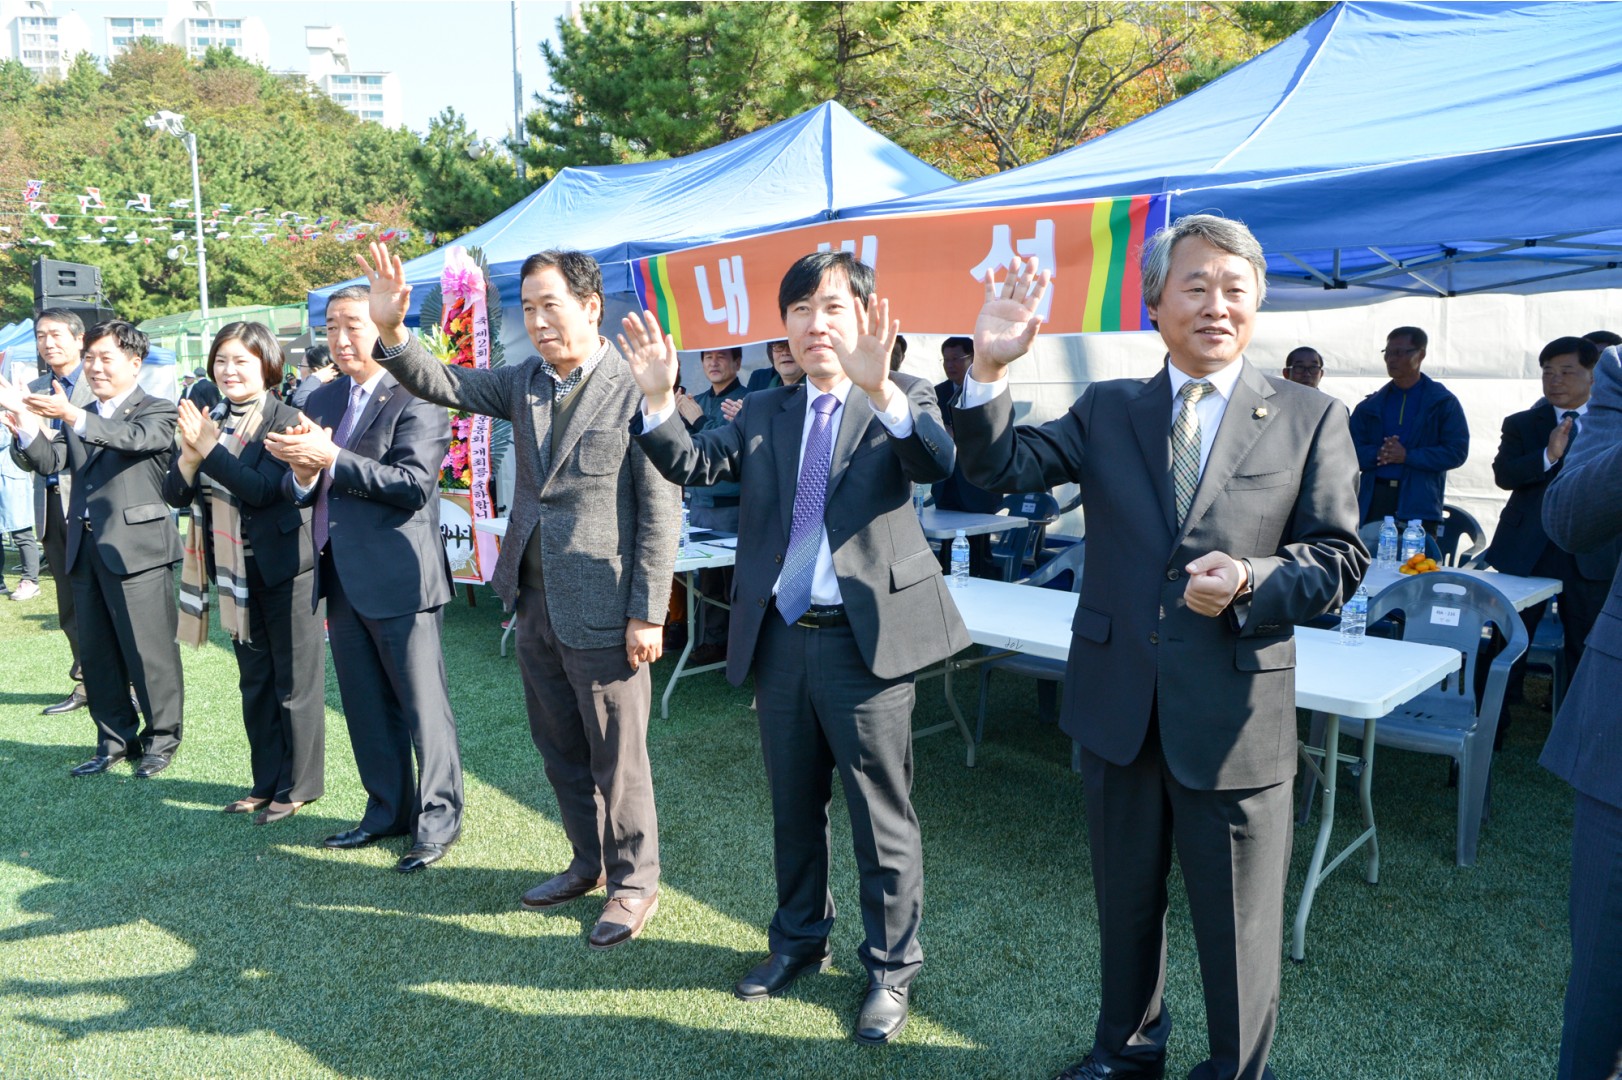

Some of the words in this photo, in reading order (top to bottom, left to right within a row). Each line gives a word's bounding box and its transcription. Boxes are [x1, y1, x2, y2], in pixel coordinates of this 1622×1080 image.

[475, 316, 487, 324] 축
[475, 328, 487, 357] 제2회
[472, 447, 488, 477] 개회를
[473, 480, 489, 519] 축하합니
